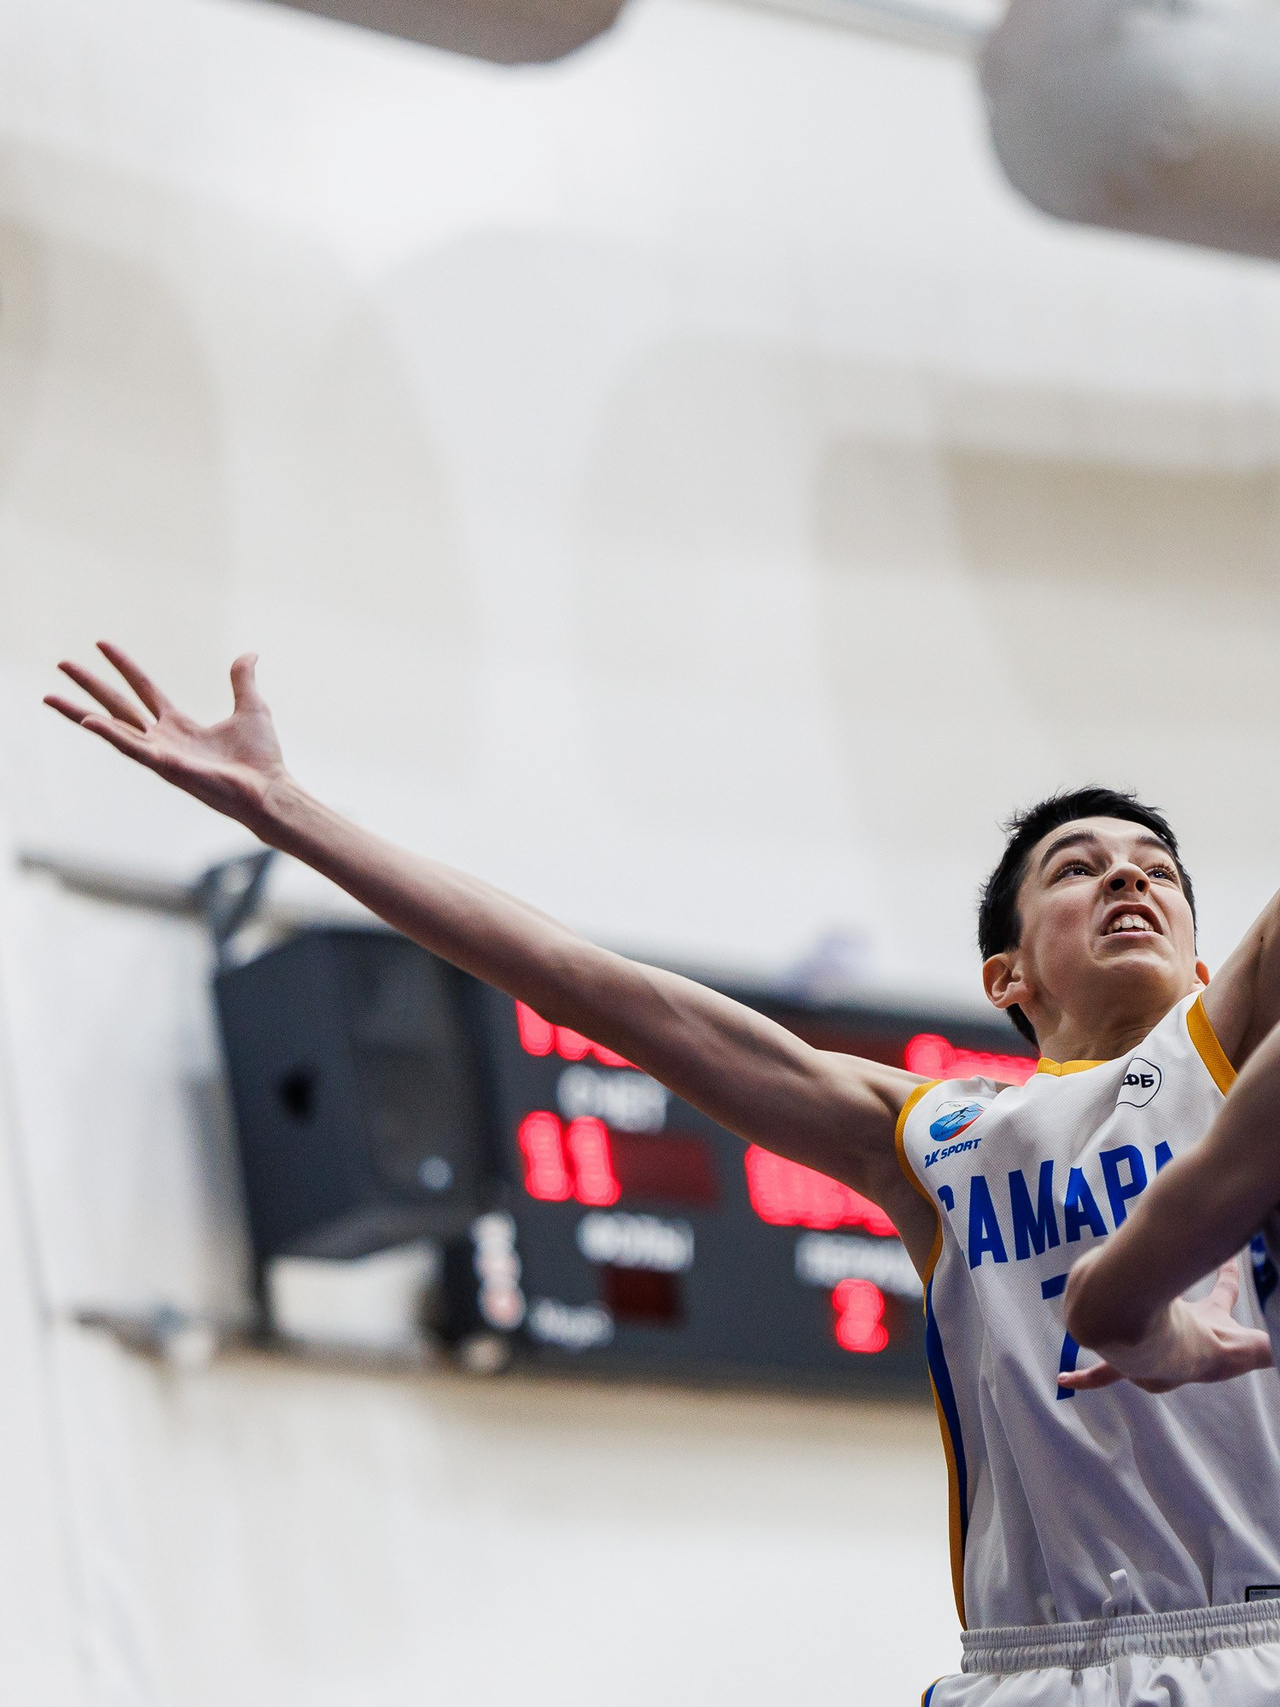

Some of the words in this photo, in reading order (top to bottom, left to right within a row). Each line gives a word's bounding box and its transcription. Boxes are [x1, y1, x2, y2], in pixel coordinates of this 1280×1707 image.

[1121, 1073, 1155, 1089] ФБ
[924, 1148, 941, 1169] 2K
[940, 1138, 982, 1160] SPORT
